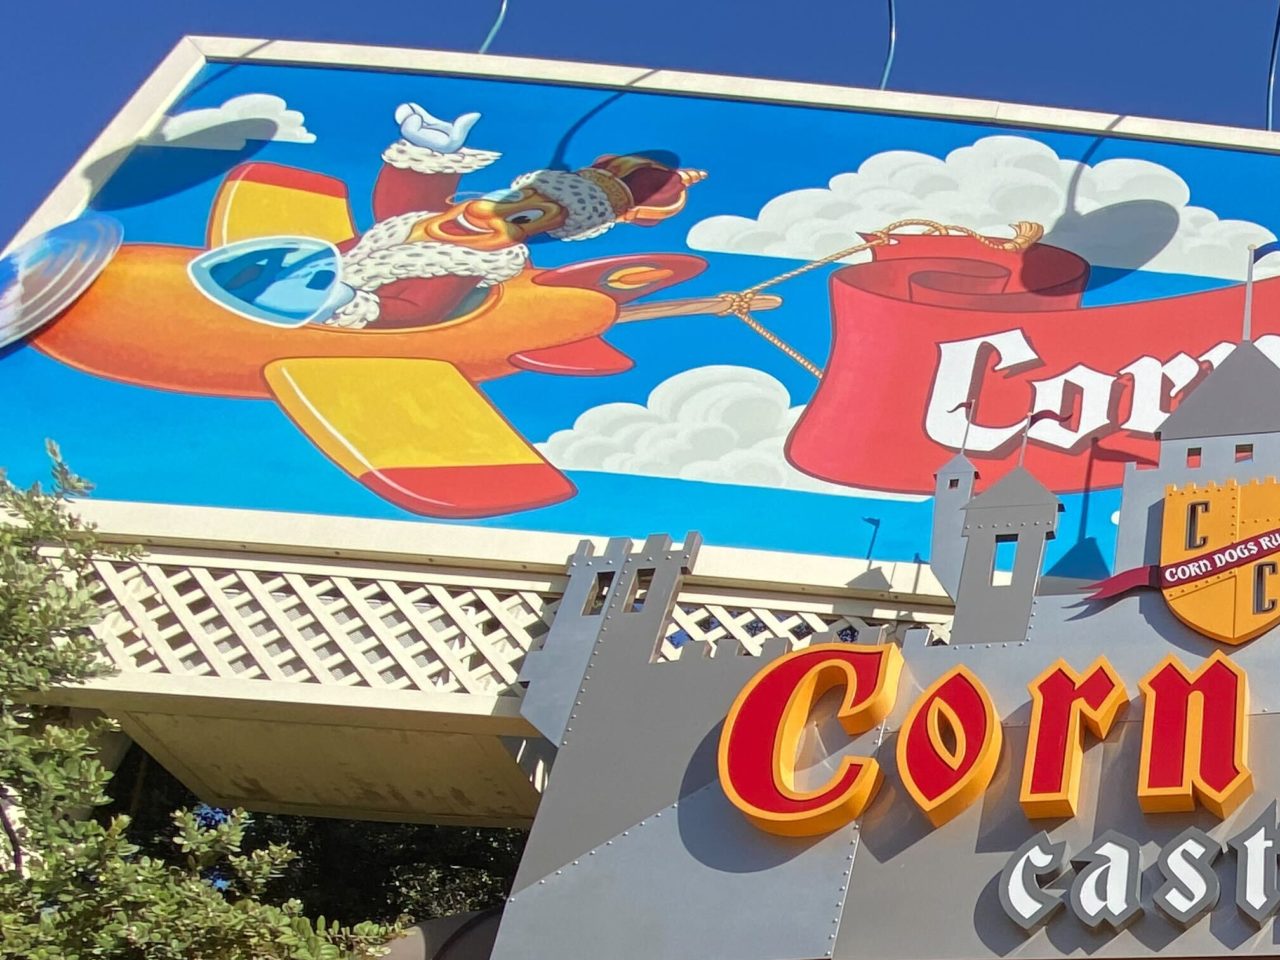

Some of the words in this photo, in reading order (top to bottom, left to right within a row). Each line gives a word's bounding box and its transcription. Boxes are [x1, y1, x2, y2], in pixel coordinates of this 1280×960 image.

[1185, 501, 1210, 550] C
[1213, 540, 1258, 566] DOGS
[1253, 562, 1278, 614] C
[717, 640, 1253, 837] Corn
